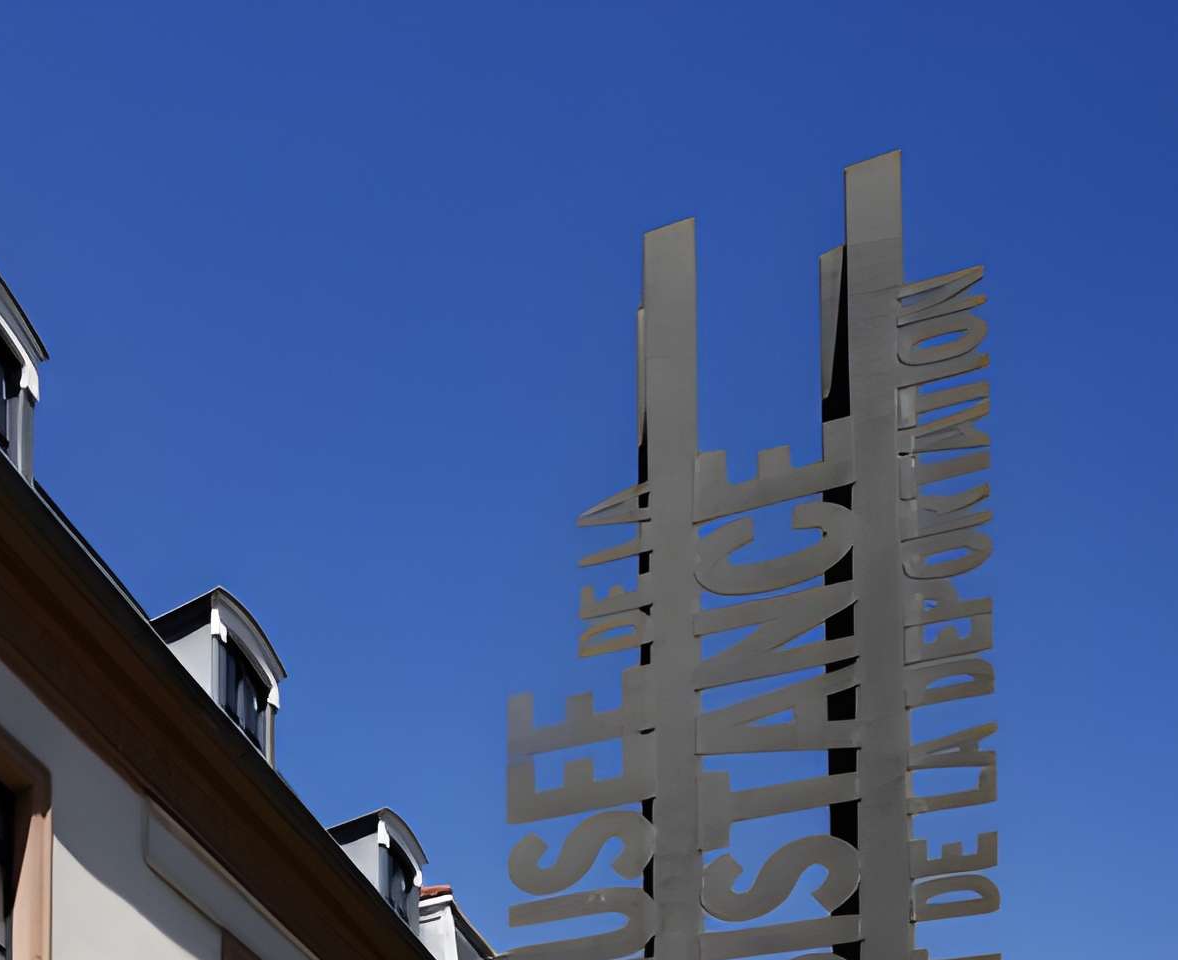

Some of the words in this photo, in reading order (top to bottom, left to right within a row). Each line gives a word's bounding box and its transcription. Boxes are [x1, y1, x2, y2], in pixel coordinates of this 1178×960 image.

[577, 481, 652, 568] LA
[896, 265, 995, 710] DEPORTATION
[578, 585, 653, 660] DE
[906, 721, 998, 816] LA
[910, 831, 1001, 923] DE
